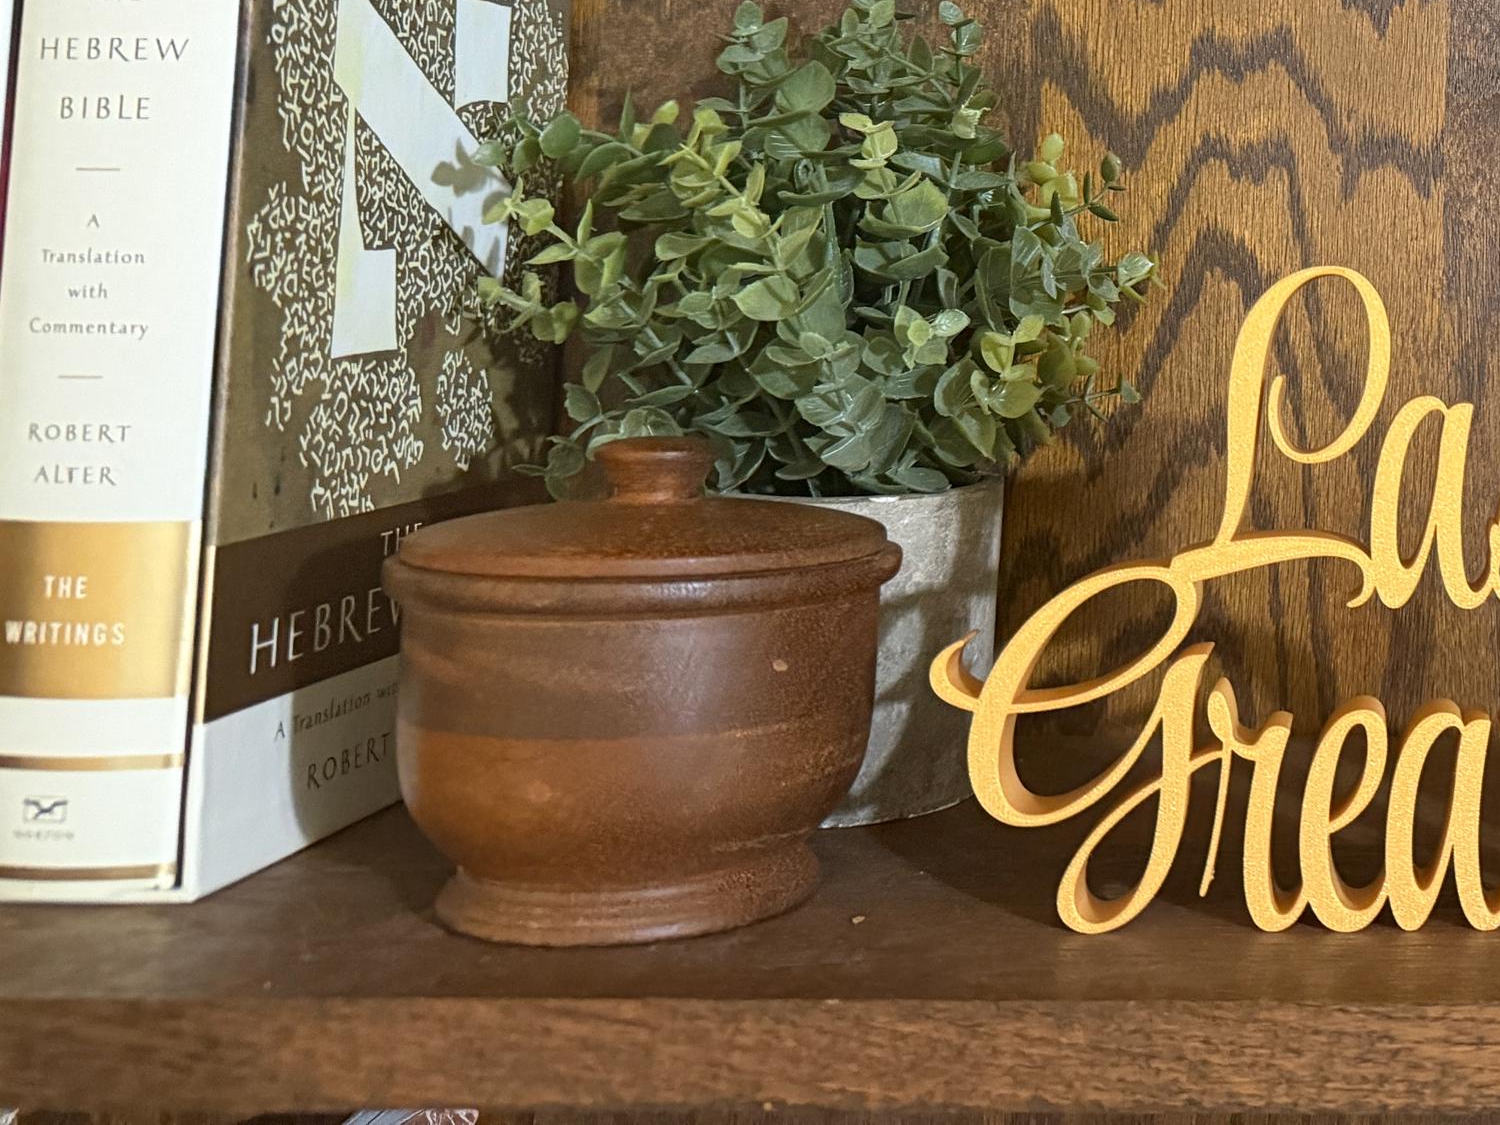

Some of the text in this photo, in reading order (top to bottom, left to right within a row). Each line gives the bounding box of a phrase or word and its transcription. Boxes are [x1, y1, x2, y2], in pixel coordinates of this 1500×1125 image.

[39, 37, 190, 63] HEBREW
[60, 95, 151, 121] BIBLE
[86, 213, 100, 228] A
[41, 248, 145, 265] Translation
[68, 283, 109, 300] with
[29, 317, 150, 340] Commentary
[28, 422, 132, 443] ROBERT
[34, 463, 117, 486] ALTER
[44, 575, 88, 599] THE
[5, 620, 125, 646] WRITINGS
[274, 720, 286, 743] A
[292, 691, 371, 735] Translation
[306, 732, 391, 790] ROBERT
